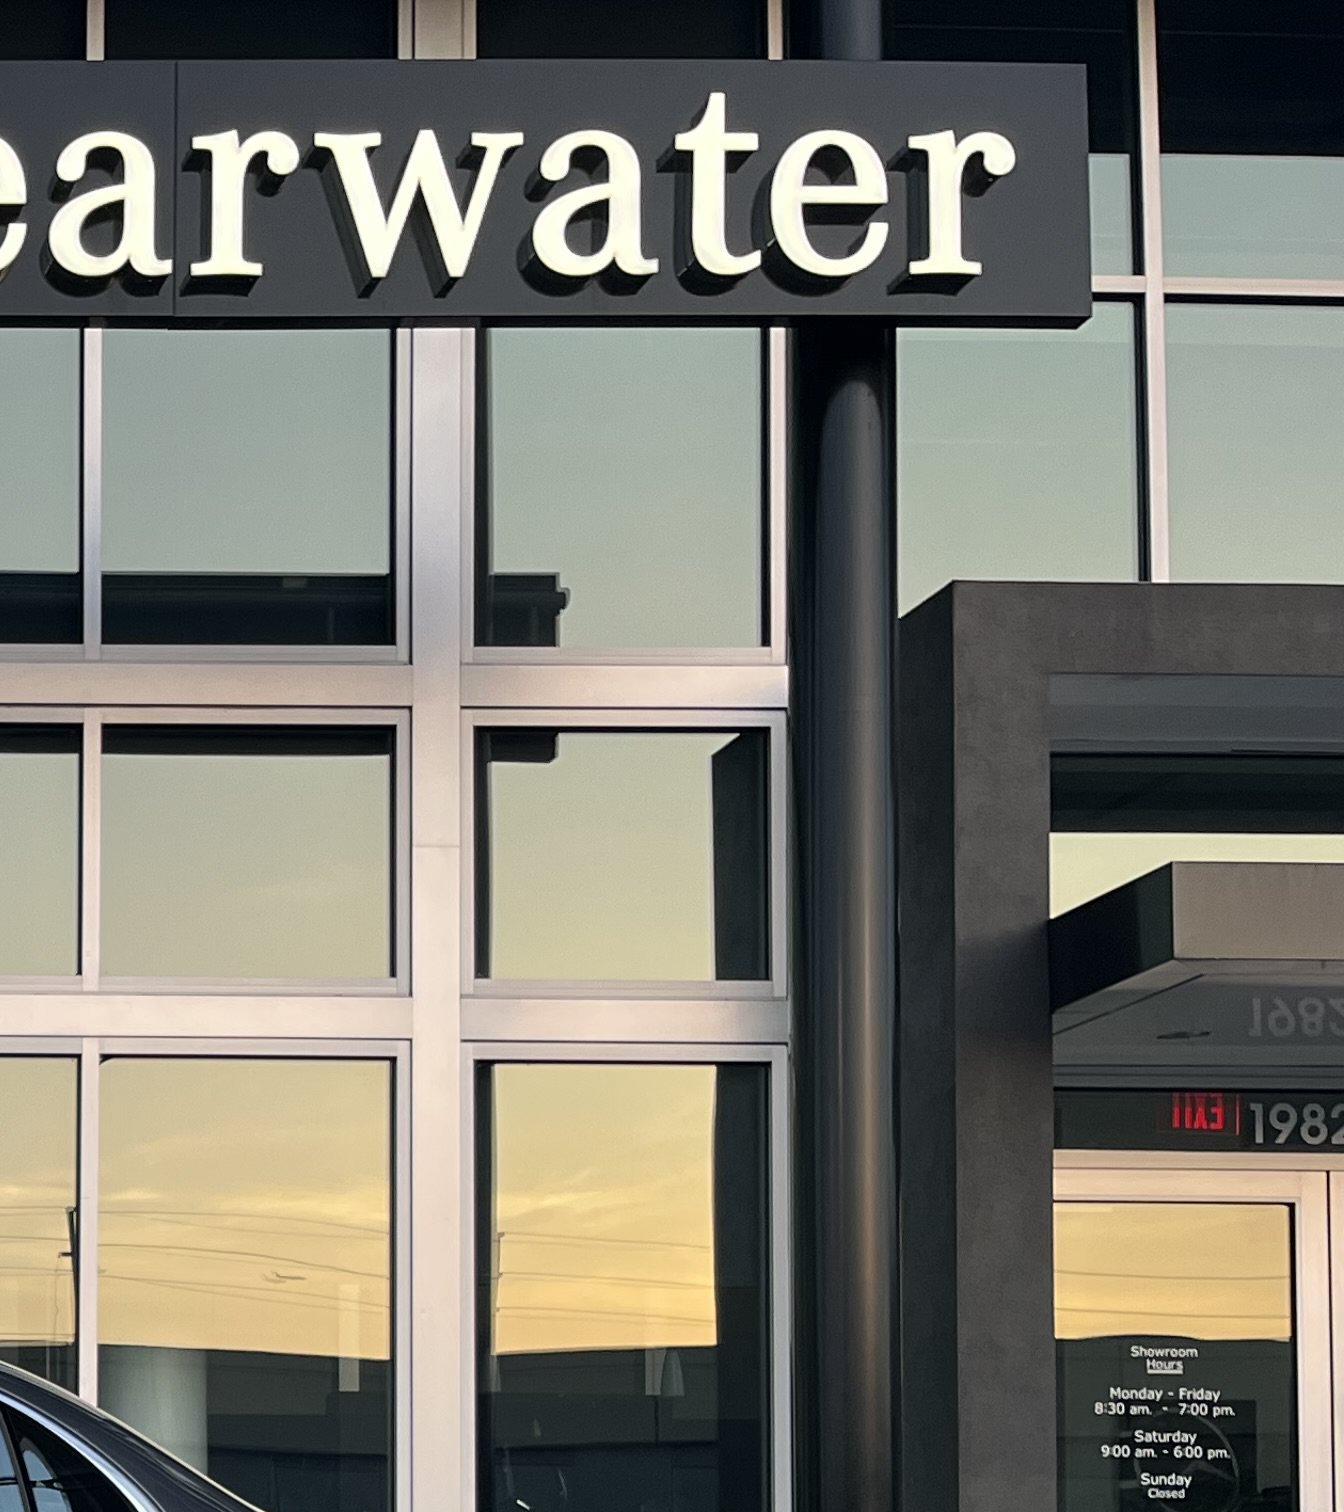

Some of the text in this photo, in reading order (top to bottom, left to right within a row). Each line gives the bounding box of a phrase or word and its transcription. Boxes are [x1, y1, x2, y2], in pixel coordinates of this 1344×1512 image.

[1130, 1346, 1199, 1358] Showroom
[1146, 1359, 1184, 1371] Hours
[1109, 1387, 1164, 1402] Monday
[1178, 1387, 1221, 1403] Friday
[1094, 1402, 1126, 1415] 8:30
[1129, 1405, 1153, 1415] am.
[1178, 1402, 1209, 1415] 7:00
[1212, 1406, 1236, 1418] pm.
[1134, 1429, 1198, 1445] Saturday
[1100, 1445, 1131, 1458] 9:00
[1134, 1448, 1158, 1458] am.
[1173, 1445, 1203, 1458] 6:00
[1207, 1448, 1231, 1460] pm.
[1140, 1472, 1193, 1488] Sunday
[1147, 1488, 1186, 1499] Closed
